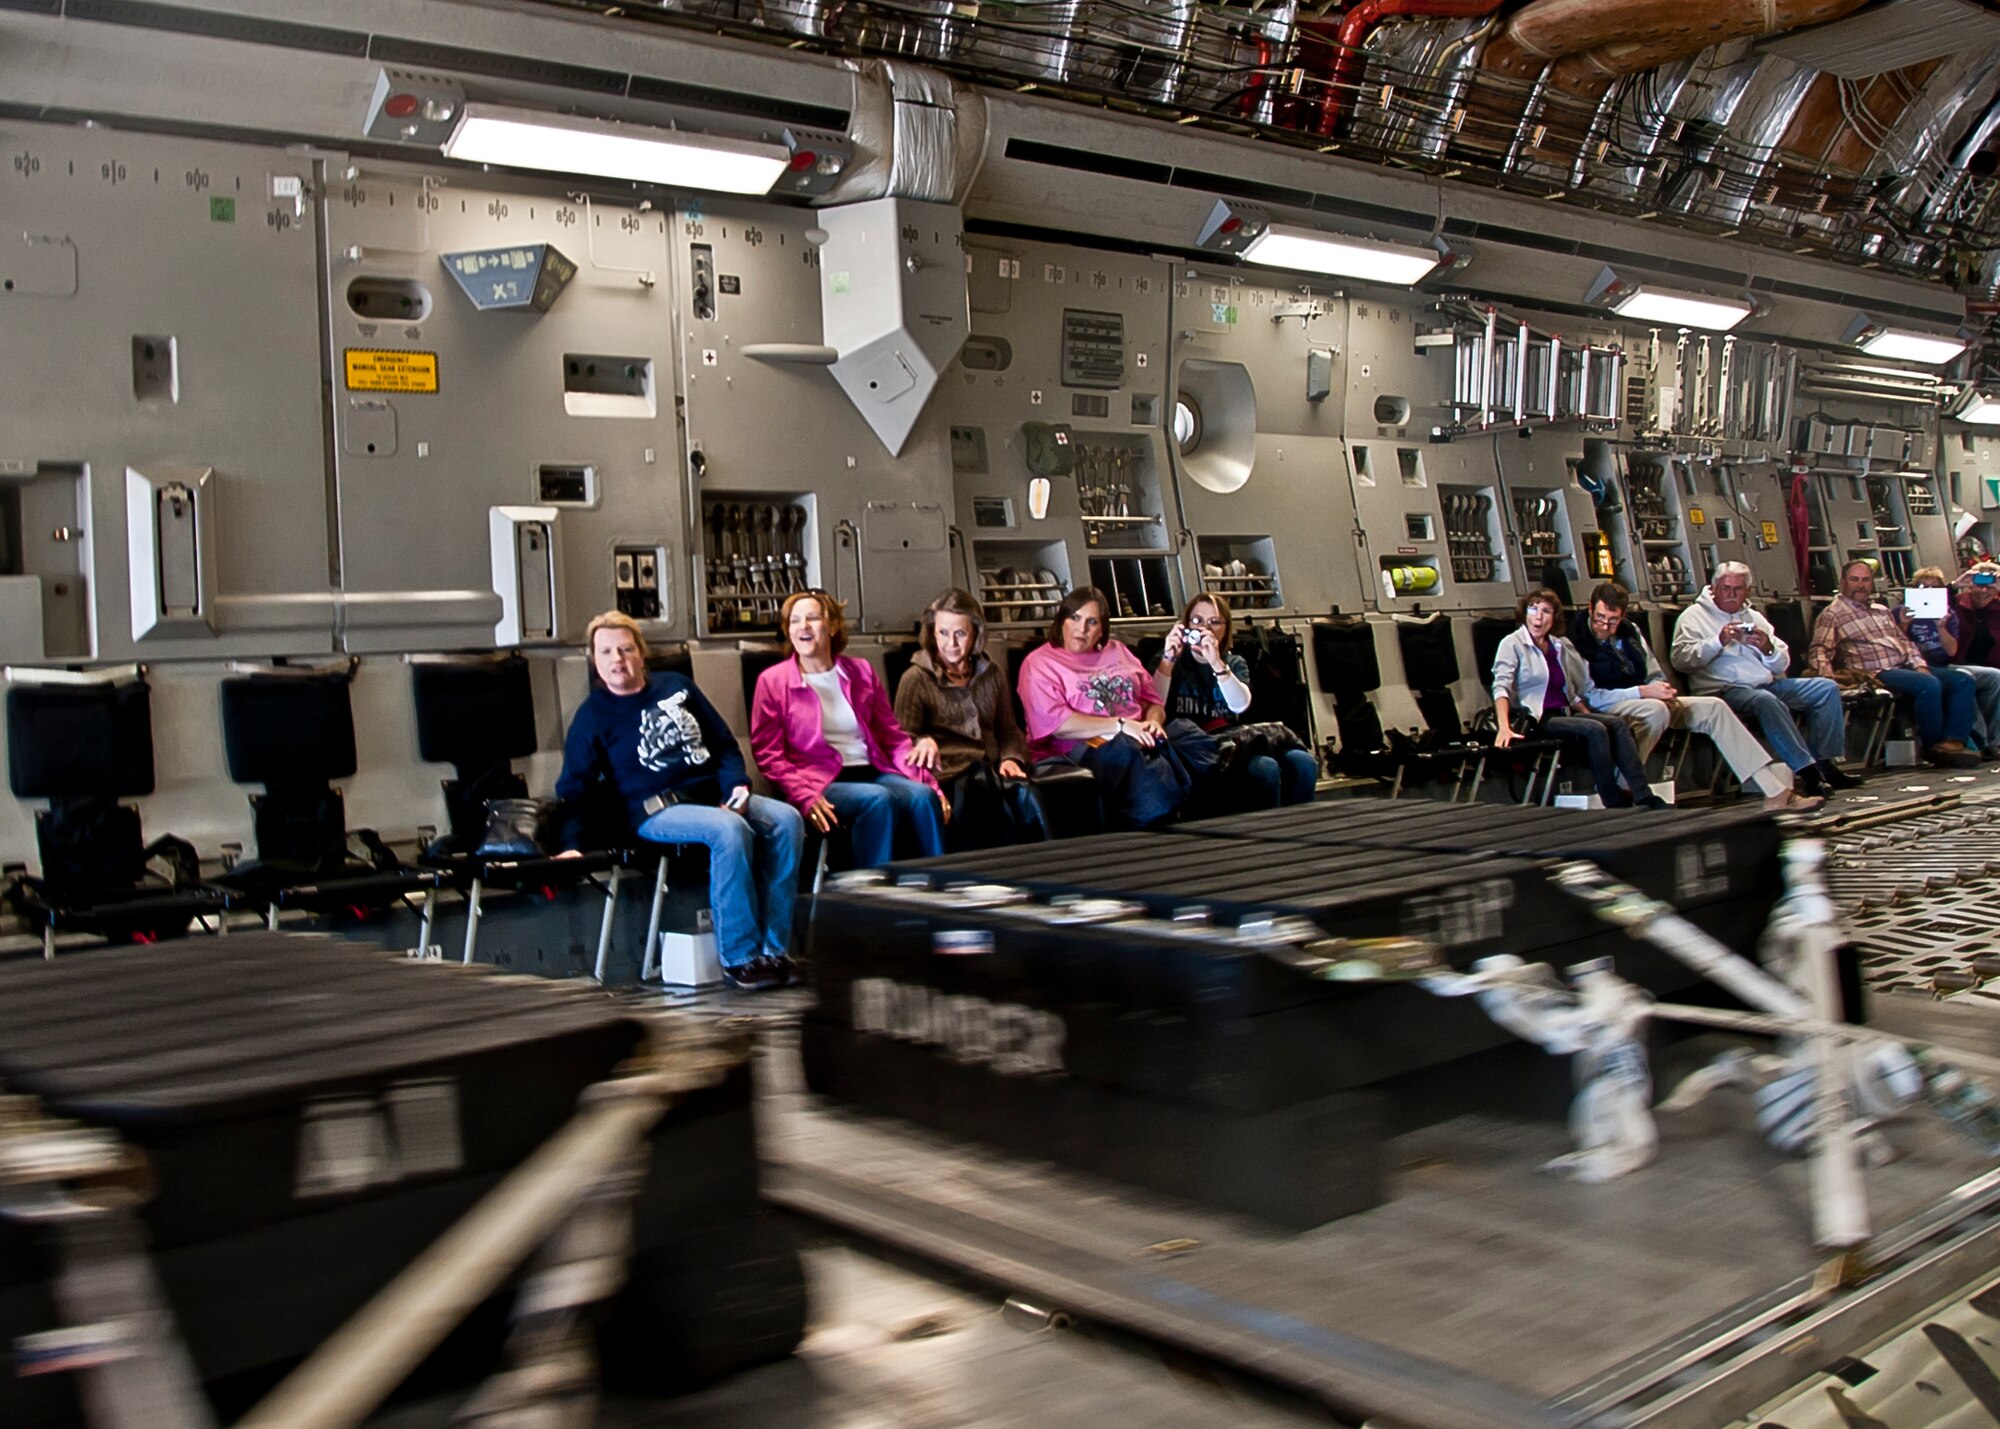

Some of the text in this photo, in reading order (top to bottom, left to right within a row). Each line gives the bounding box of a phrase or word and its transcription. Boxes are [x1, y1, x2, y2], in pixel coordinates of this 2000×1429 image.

[556, 207, 576, 227] 850
[685, 221, 703, 239] 830
[745, 226, 762, 246] 820
